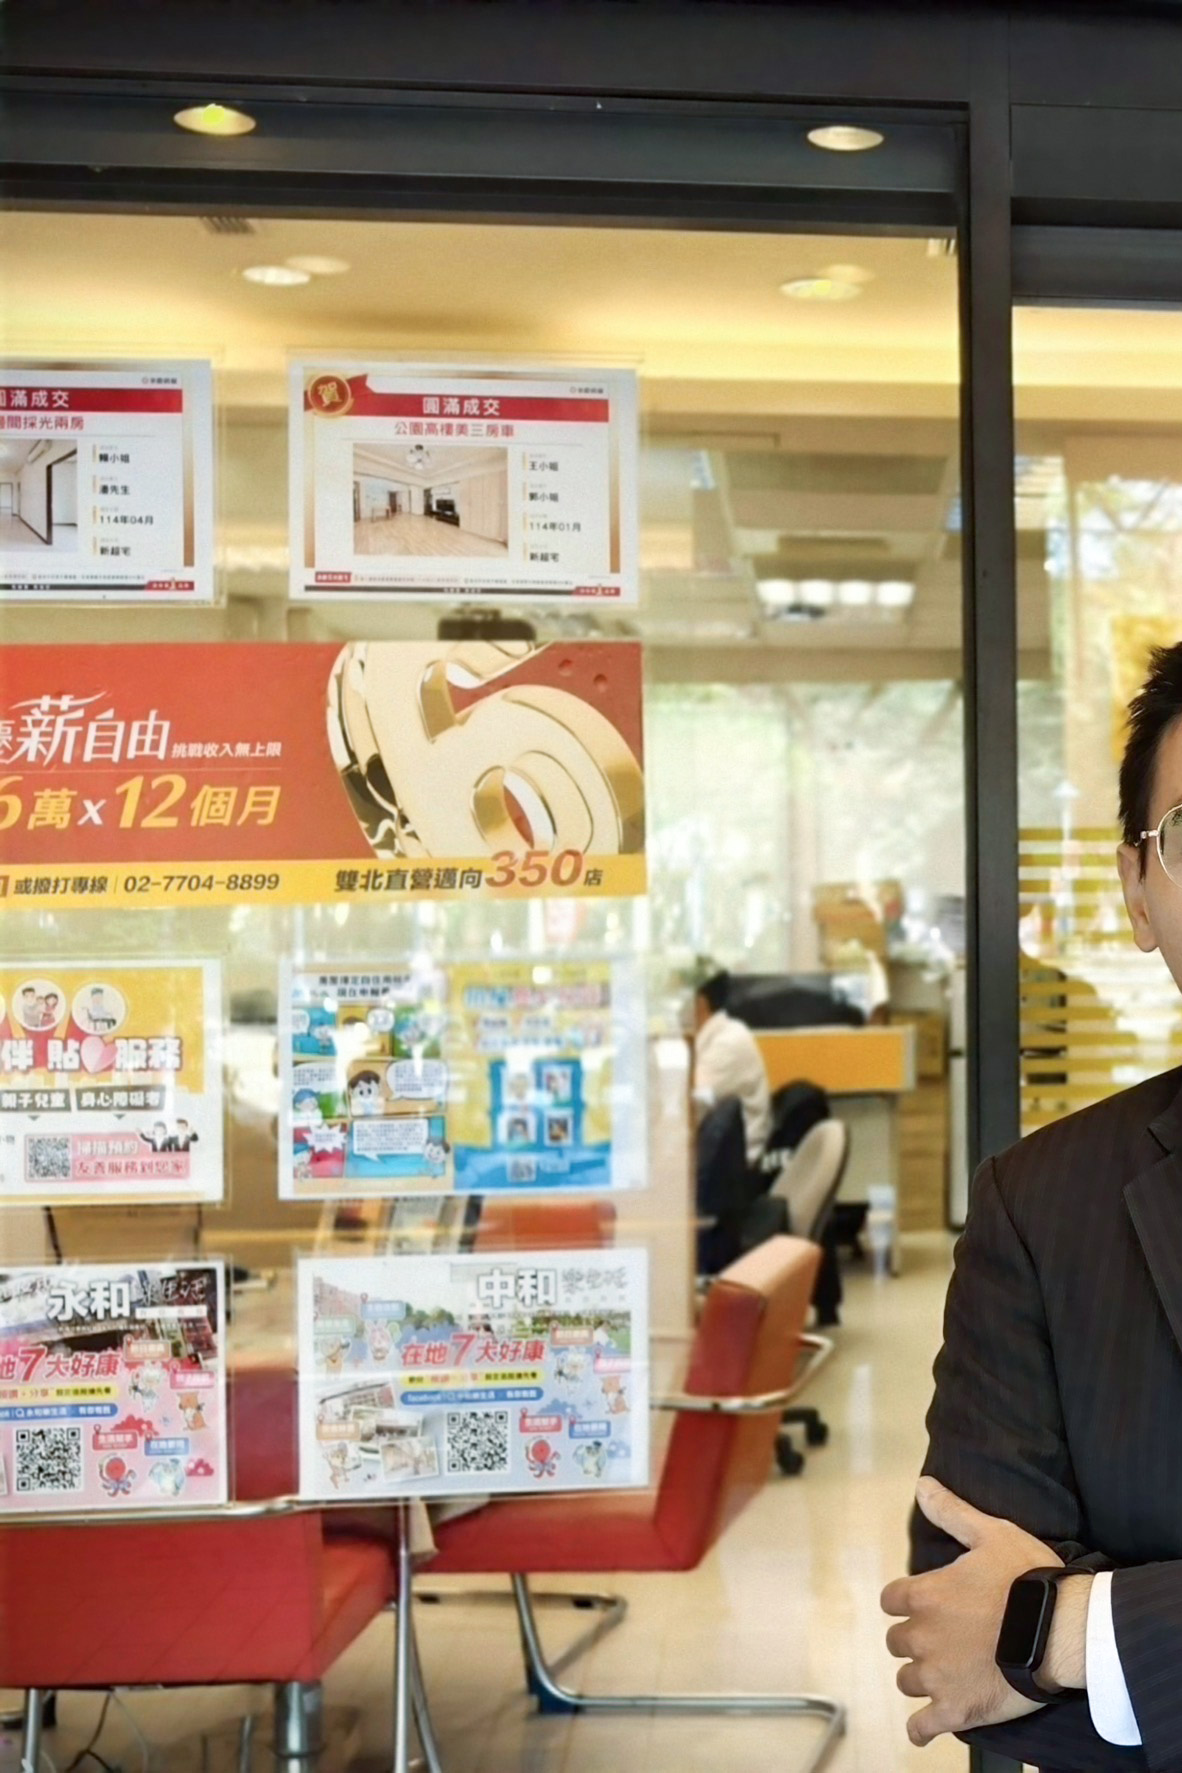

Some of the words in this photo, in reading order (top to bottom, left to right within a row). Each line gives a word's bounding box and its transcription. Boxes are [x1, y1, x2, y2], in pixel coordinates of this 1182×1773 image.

[422, 397, 500, 416] 圓滿成交
[395, 422, 514, 437] 公園高樓美三房車
[171, 742, 282, 759] 挑戰收入無上限
[13, 876, 108, 896] 或撥打專線
[124, 873, 280, 894] 02-7704-8899
[334, 850, 603, 892] 雙北直營邁向350店
[47, 1281, 131, 1320] 永和
[478, 1268, 557, 1308] 中和
[402, 1334, 546, 1366] 在地7大好康
